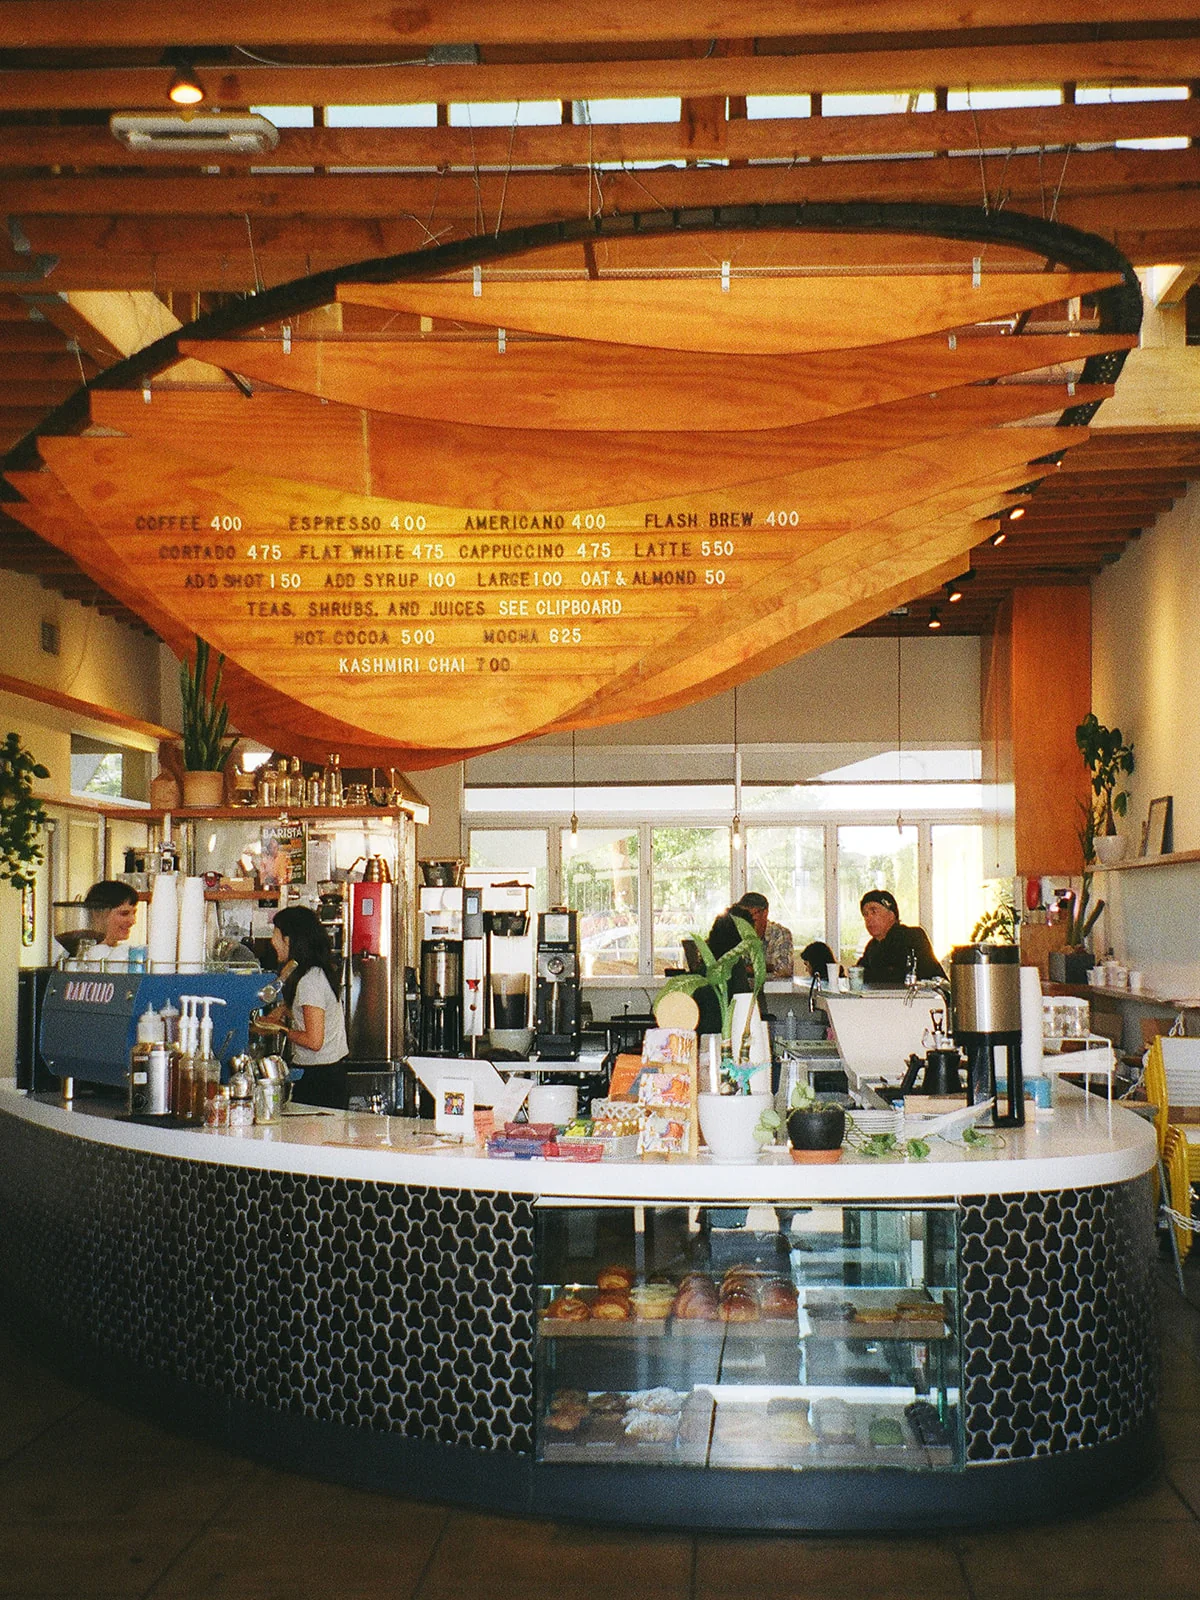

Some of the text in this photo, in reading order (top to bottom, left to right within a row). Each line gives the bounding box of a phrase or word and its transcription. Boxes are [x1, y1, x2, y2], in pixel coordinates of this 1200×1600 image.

[135, 510, 799, 531] COFFEE 400 ESPRESSO 400 AMERICANO 400 FLASH BREW 400
[158, 540, 734, 560] CORTADO 475 FLAT WHITE 475 CAPPUCCINO 475 LATTE 550
[184, 569, 726, 589] ADD SHOT 150 ADD SYRUP 100 LARGE 100 OAT & ALMOND 50
[387, 600, 420, 617] AND
[429, 601, 485, 617] JUICES
[499, 600, 529, 616] SEE
[536, 599, 622, 616] CLIPBOARD
[294, 628, 582, 646] HOT COCOA 500 MOCHA 625
[339, 657, 419, 673] KASHMIRI
[428, 657, 465, 673] CHAI
[263, 826, 303, 839] BARISTA
